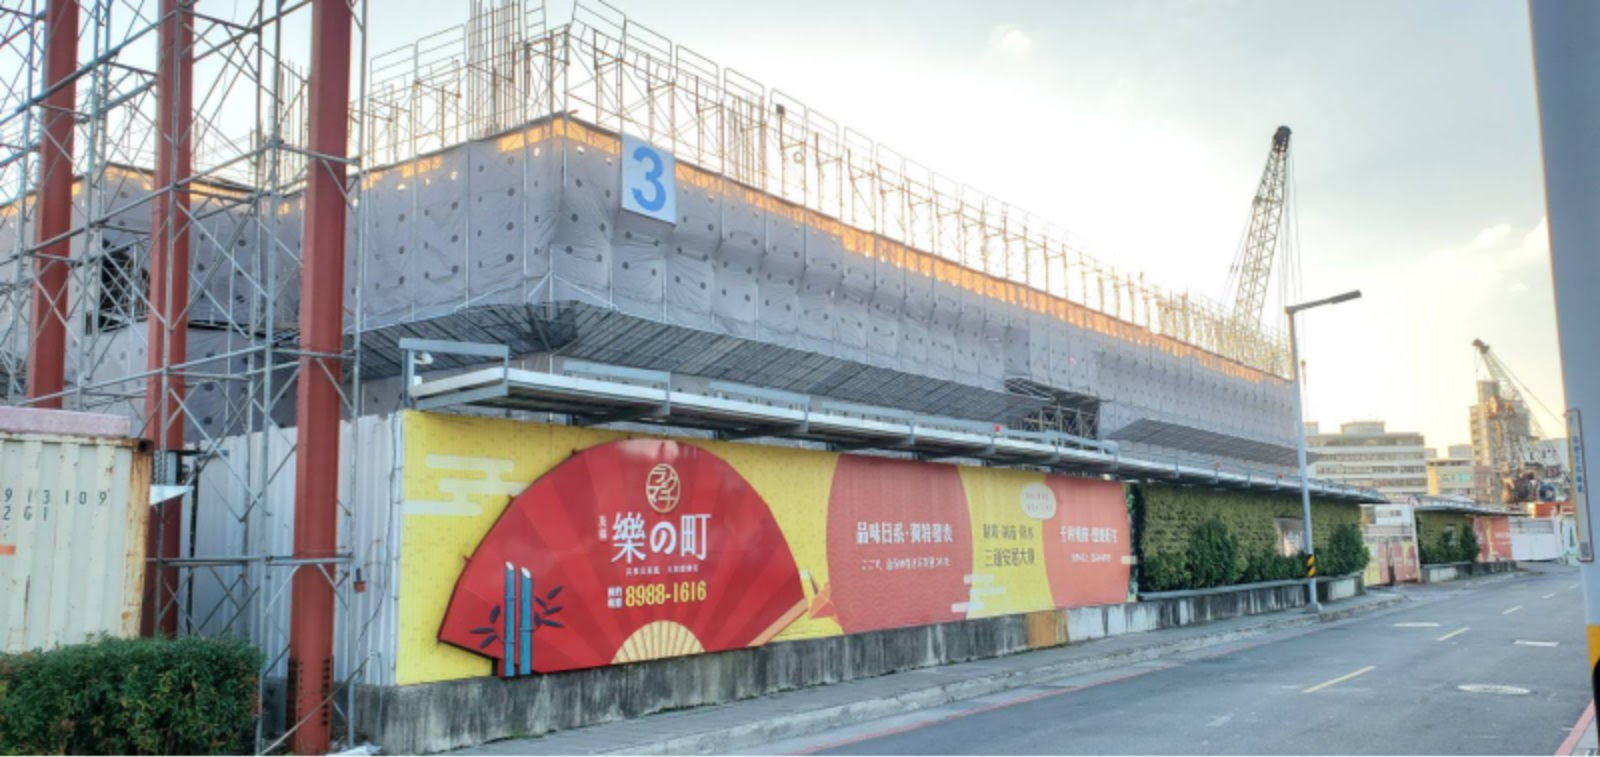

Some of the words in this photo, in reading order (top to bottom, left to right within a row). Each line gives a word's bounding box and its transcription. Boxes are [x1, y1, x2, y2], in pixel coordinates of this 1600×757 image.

[631, 146, 667, 212] 3
[611, 512, 711, 563] 樂の町
[625, 581, 707, 607] 8988-1616
